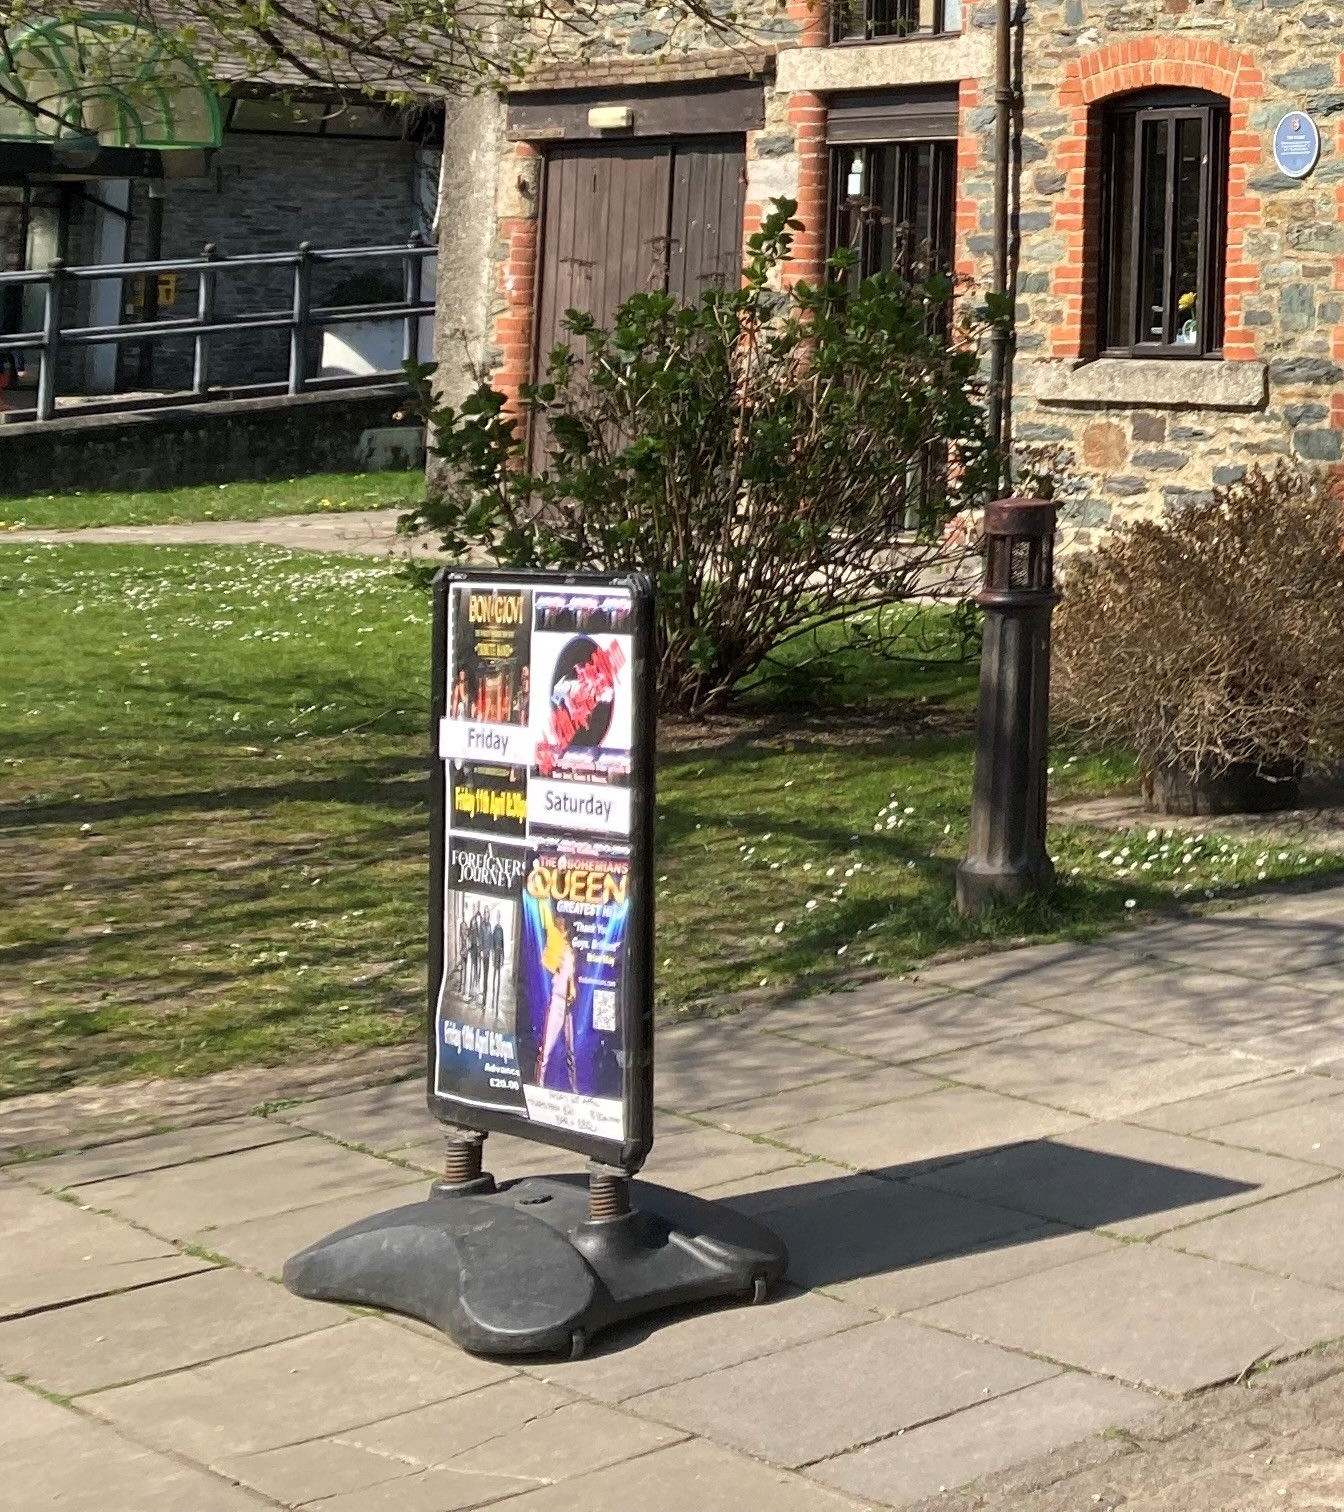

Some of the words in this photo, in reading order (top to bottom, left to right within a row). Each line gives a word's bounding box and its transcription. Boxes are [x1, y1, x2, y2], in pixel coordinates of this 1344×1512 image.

[467, 727, 510, 756] Friday
[545, 791, 612, 822] Saturday
[458, 864, 515, 889] JOURNEY
[526, 866, 628, 904] QUEEN
[556, 900, 598, 916] GREATEST
